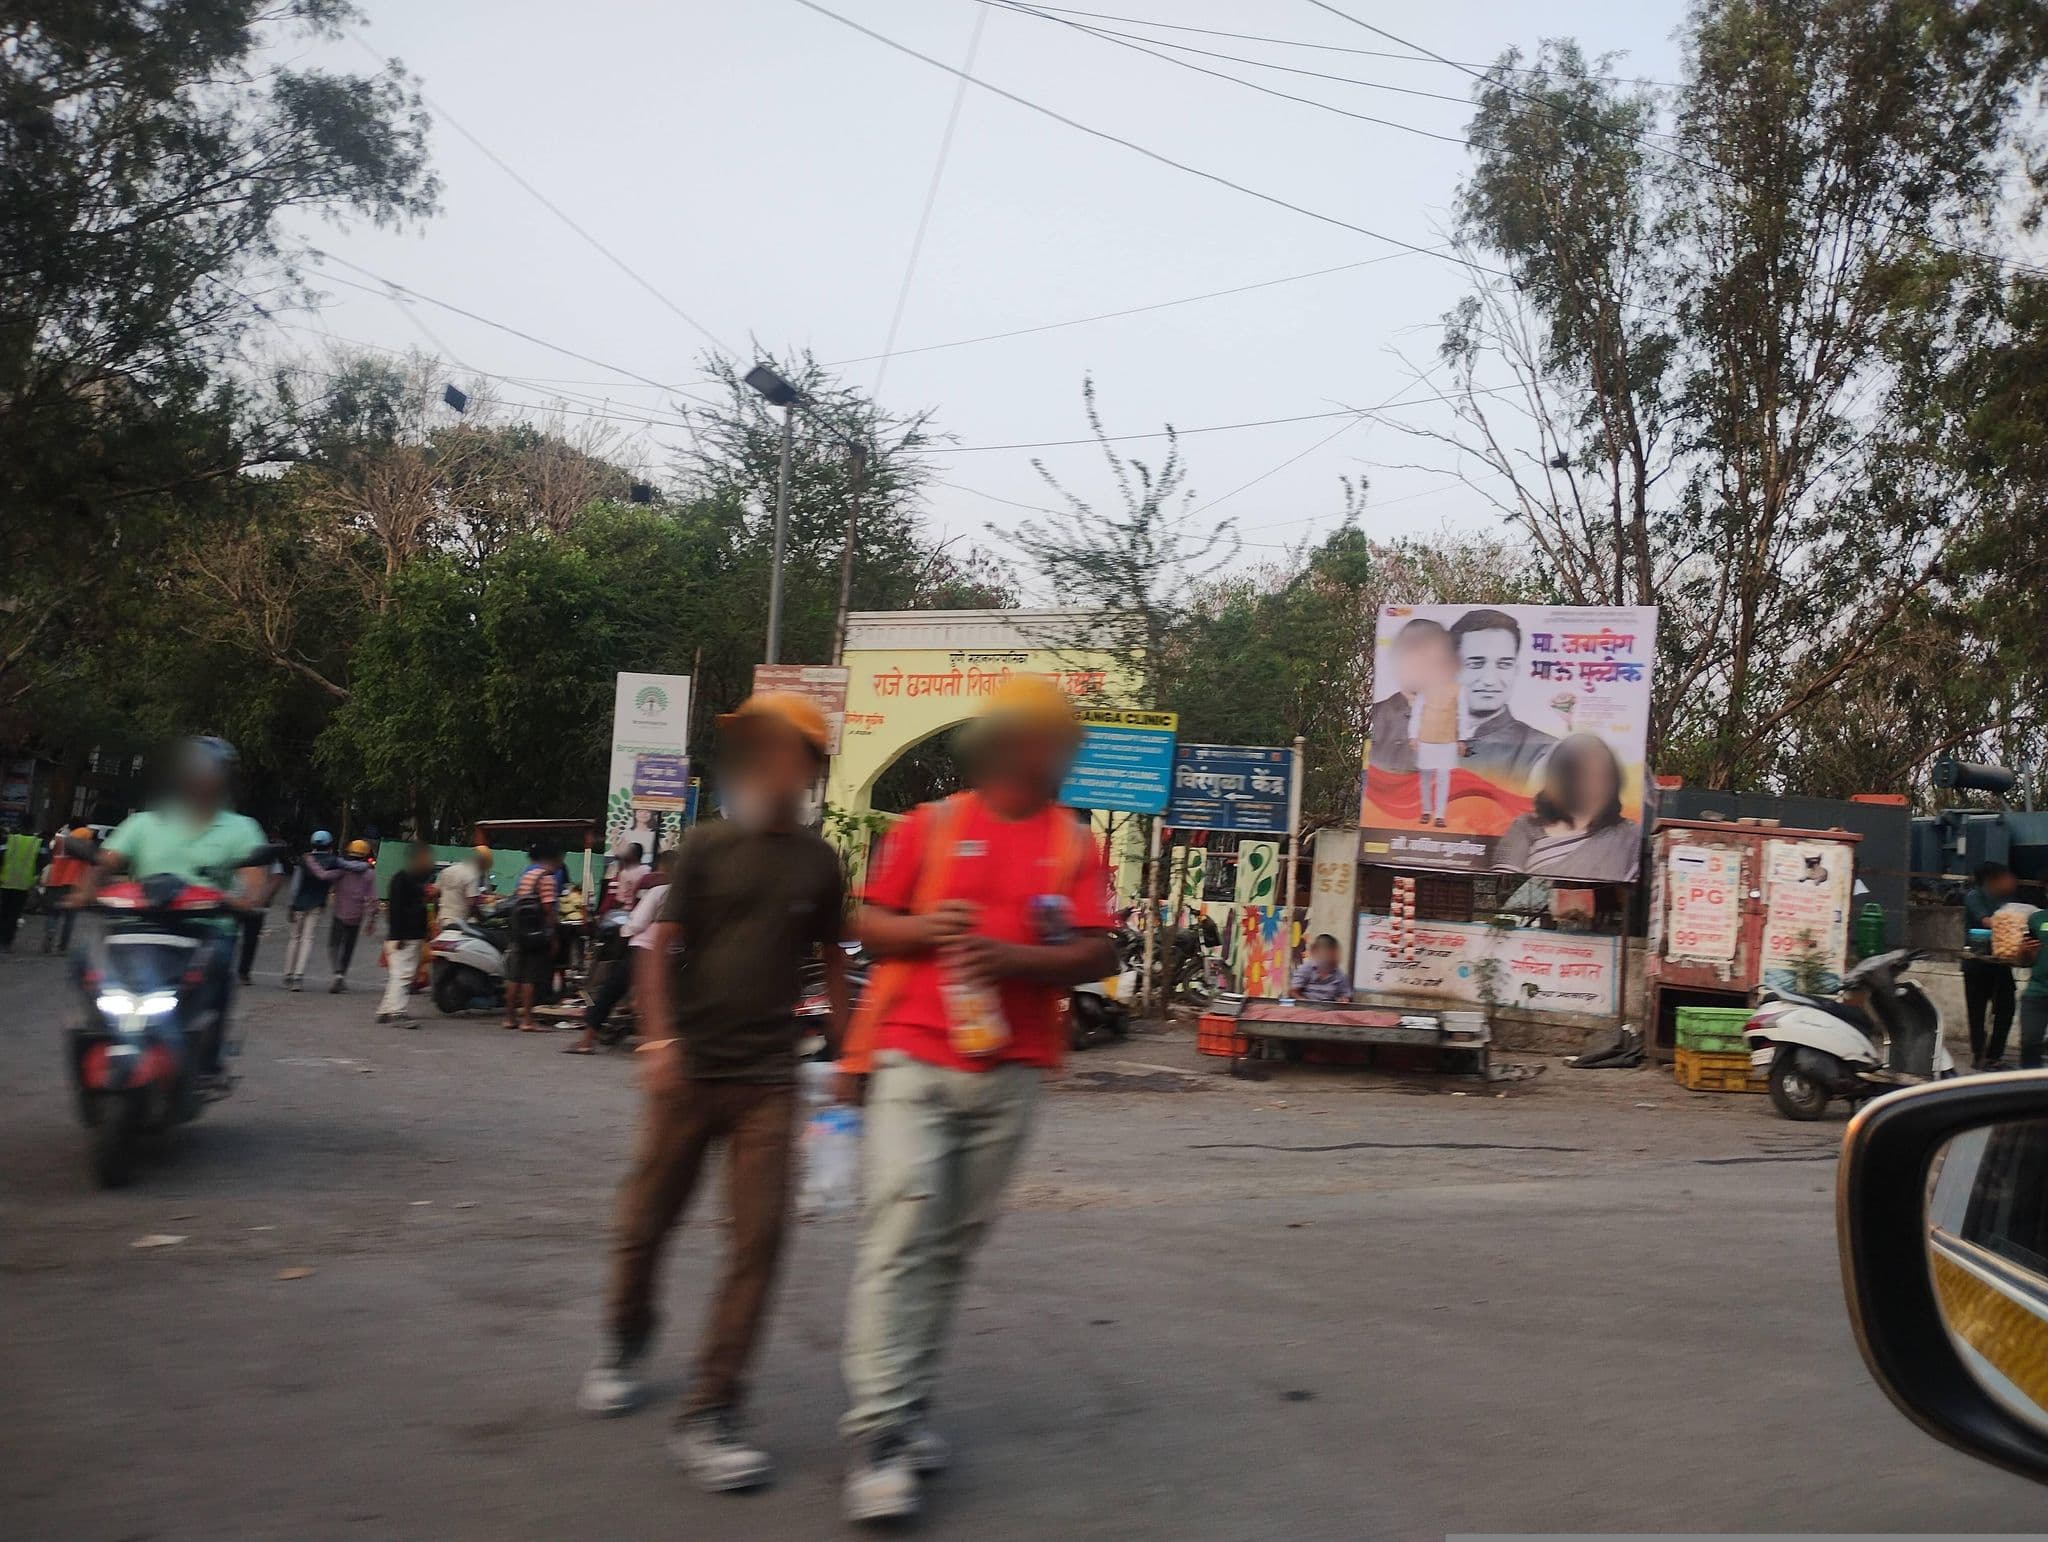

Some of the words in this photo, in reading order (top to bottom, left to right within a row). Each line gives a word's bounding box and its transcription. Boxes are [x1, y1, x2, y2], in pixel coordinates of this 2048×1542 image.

[873, 666, 904, 697] राजे
[906, 667, 964, 699] छत्रपती
[1126, 714, 1172, 726] CLINIC
